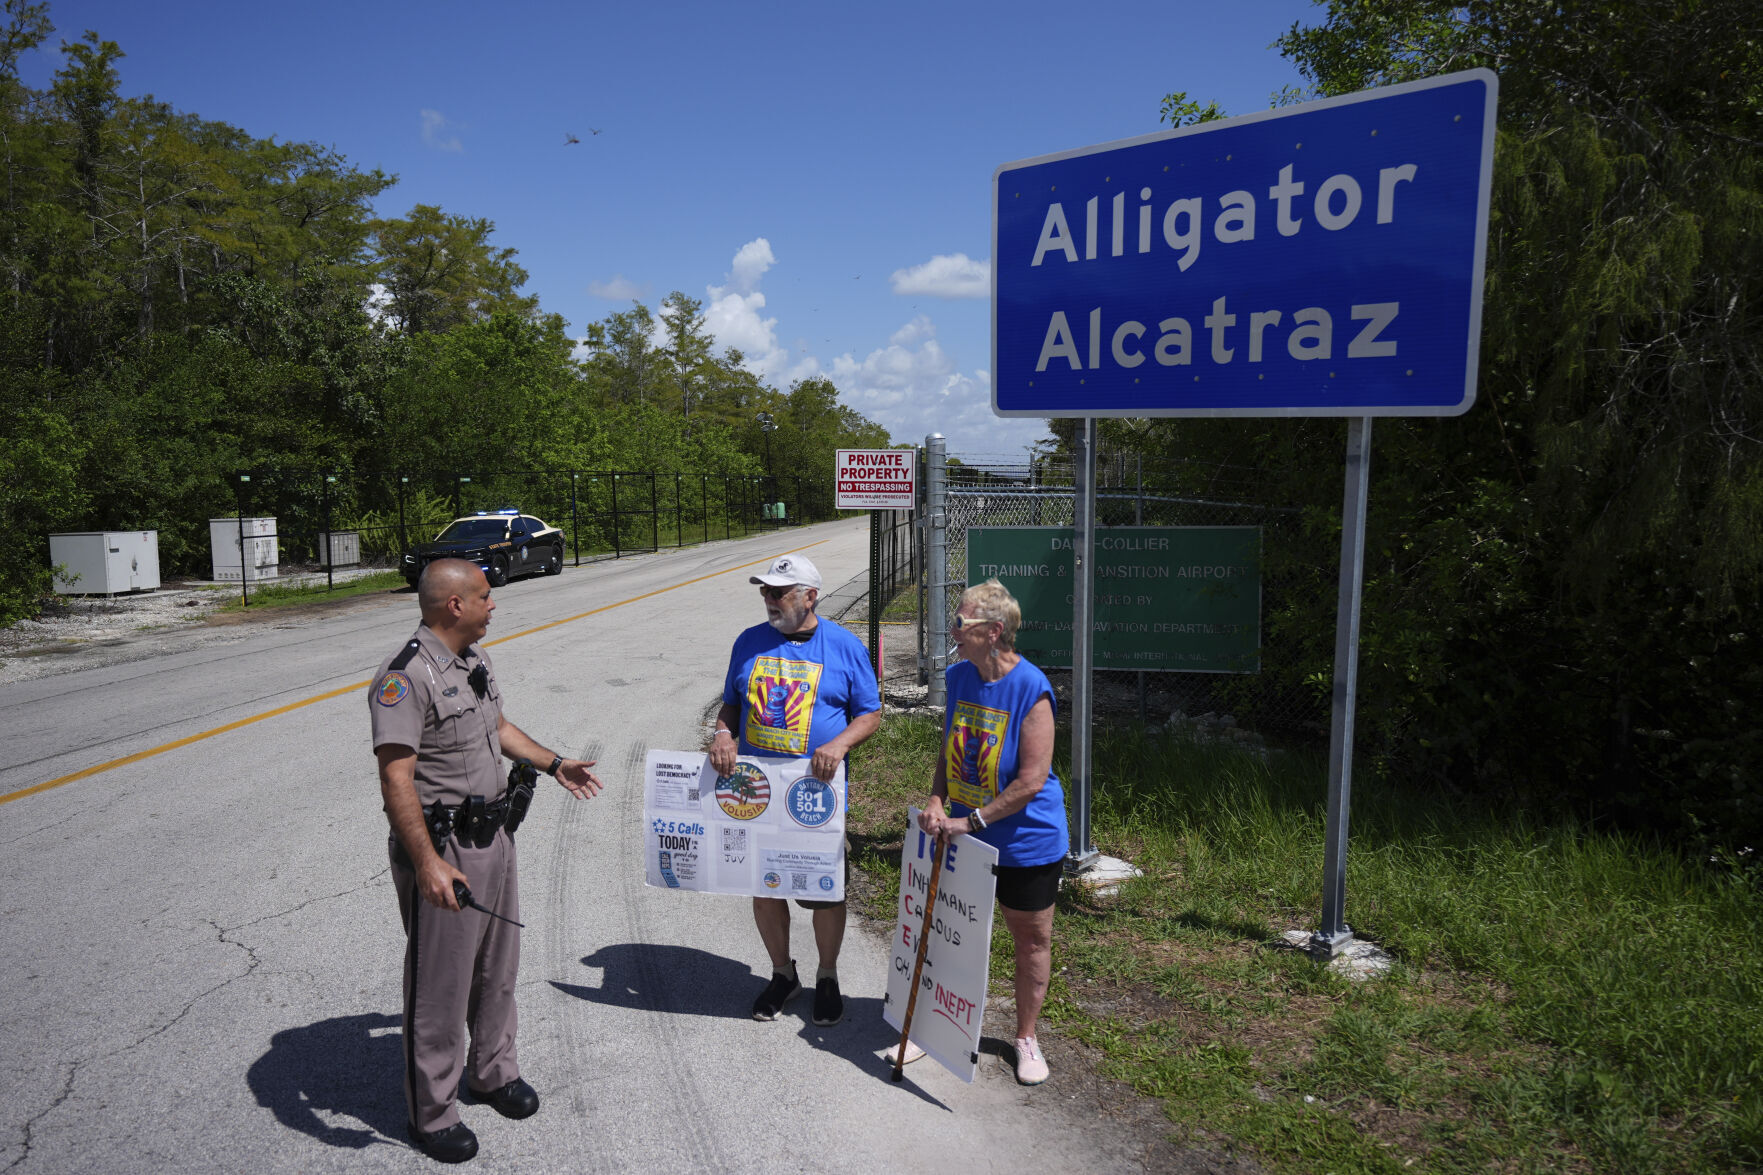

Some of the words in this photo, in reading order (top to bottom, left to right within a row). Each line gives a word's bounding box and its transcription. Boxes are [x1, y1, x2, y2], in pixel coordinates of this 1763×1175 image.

[1030, 163, 1418, 273] Alligator
[1034, 296, 1400, 372] Alcatraz
[848, 454, 903, 466] PRIVATE
[840, 467, 909, 480] PROPERTY
[840, 483, 853, 491] NO
[855, 483, 910, 492] TRESPASSING
[1051, 537, 1169, 551] DA-COLLIER
[978, 564, 1050, 577] TRAINING
[1057, 565, 1067, 577] &
[1095, 566, 1169, 579] ANSITION
[1177, 566, 1248, 579] AIRPORT
[1137, 595, 1152, 606] BY
[667, 771, 691, 779] DEMOCRACY
[750, 767, 763, 781] US
[798, 781, 825, 791] DAYTONA
[723, 800, 763, 818] VOLUSIA
[800, 812, 822, 822] BEACH
[668, 822, 675, 834] 5
[658, 835, 691, 851] TODAY
[908, 861, 977, 923] INHMANE
[904, 894, 961, 946] CALOUS
[902, 924, 933, 967] EVL
[935, 983, 976, 1025] INEPT
